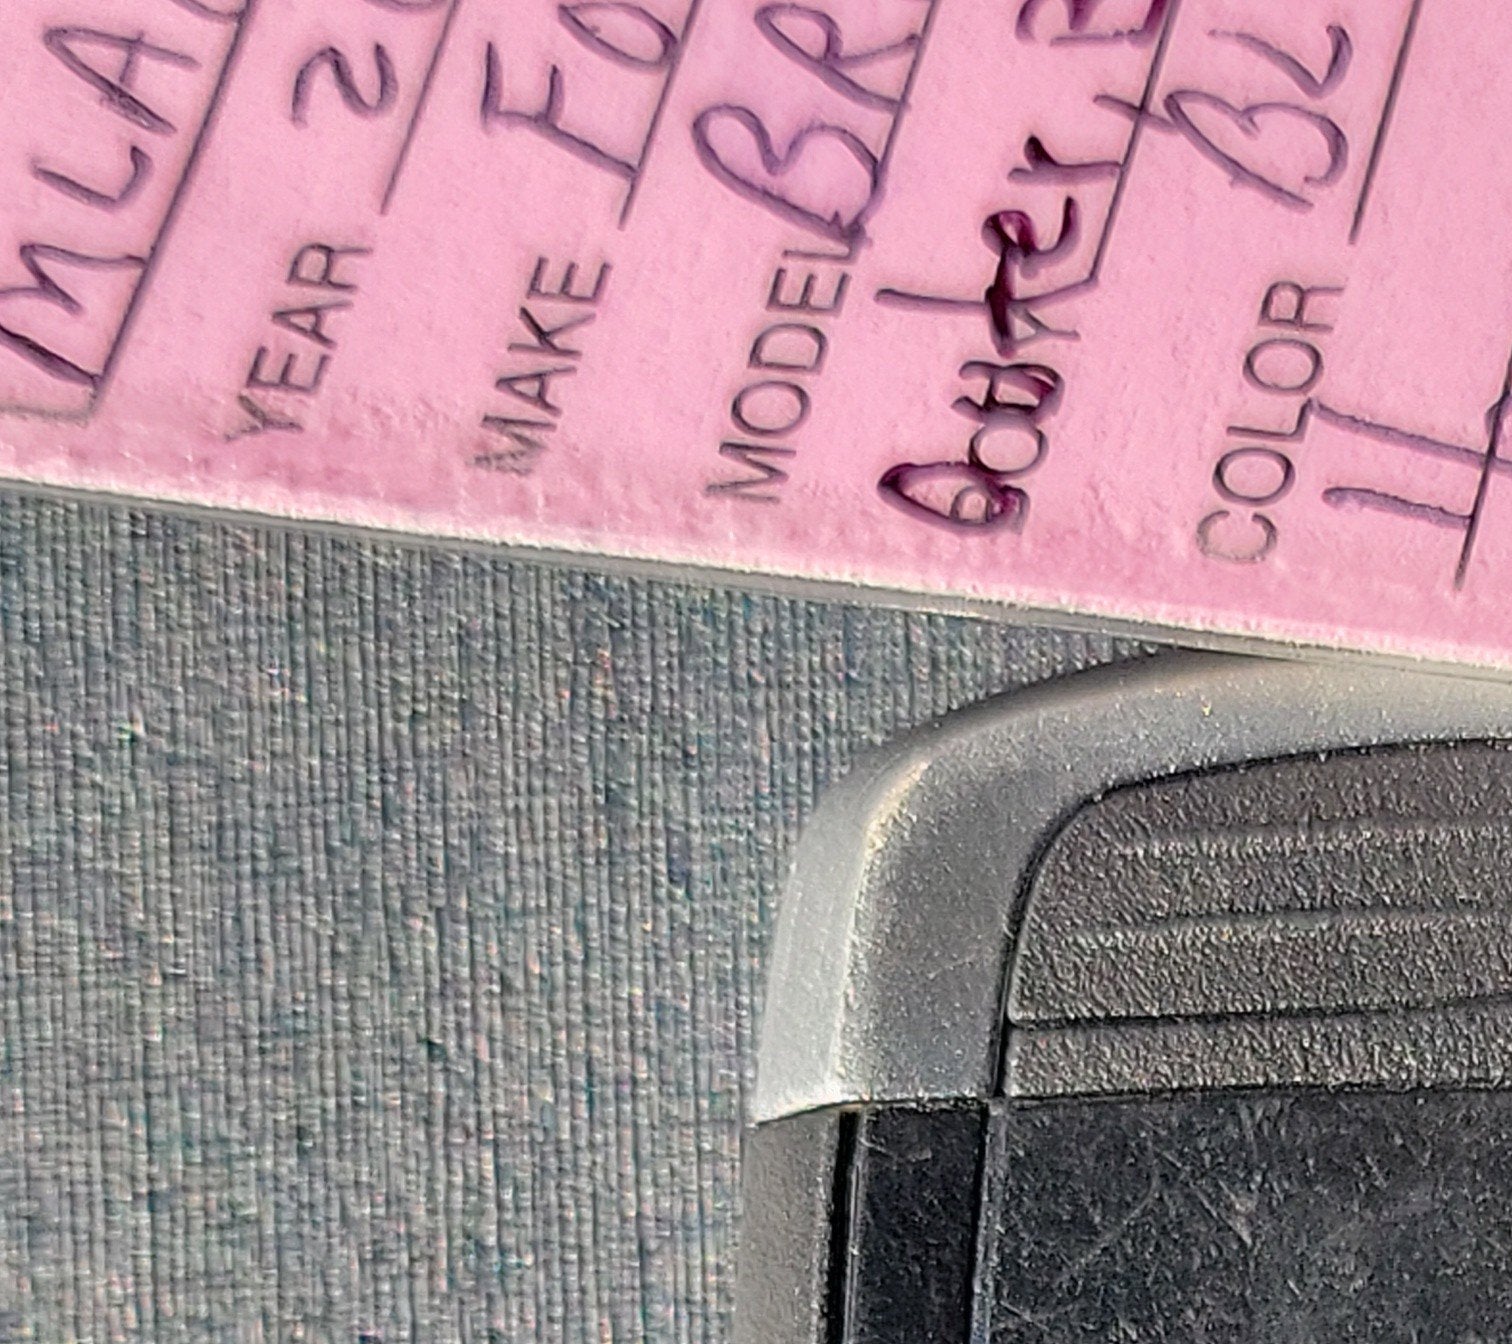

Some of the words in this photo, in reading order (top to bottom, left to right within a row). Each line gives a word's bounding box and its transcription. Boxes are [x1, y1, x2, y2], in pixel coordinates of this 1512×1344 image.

[224, 242, 373, 441] YEAR
[466, 255, 611, 475] MAKE
[705, 222, 865, 503] MODEL
[1198, 278, 1348, 563] COLOR
